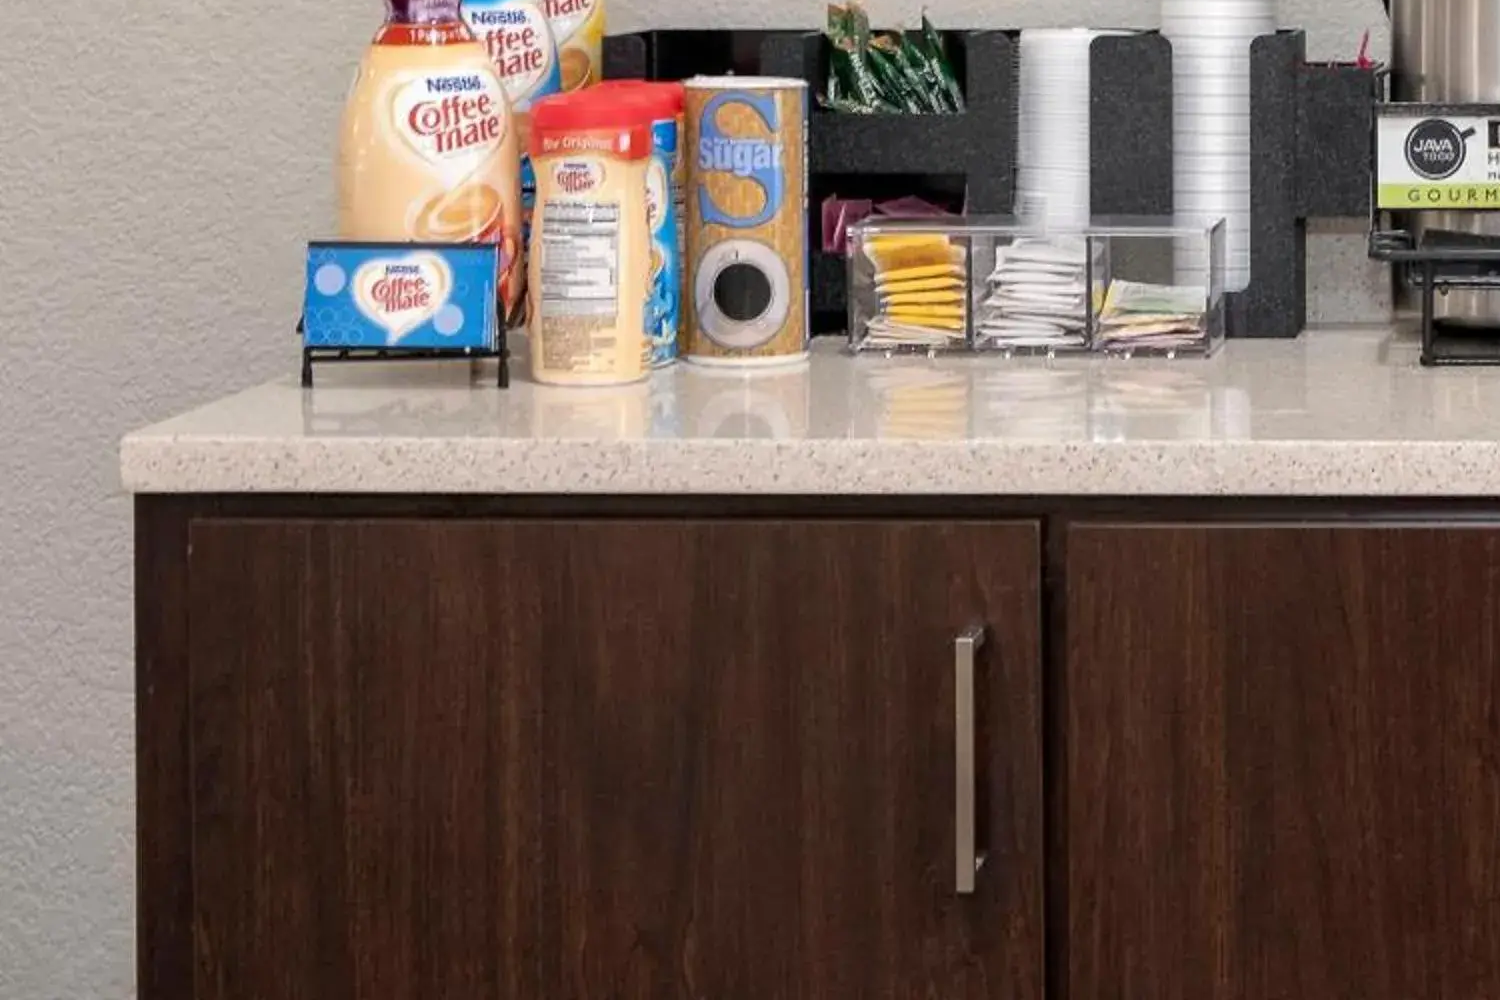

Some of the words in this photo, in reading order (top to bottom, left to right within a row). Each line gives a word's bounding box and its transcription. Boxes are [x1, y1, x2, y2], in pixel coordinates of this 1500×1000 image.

[486, 27, 535, 56] ffee
[408, 94, 492, 136] Coffee
[435, 115, 500, 153] mate
[1412, 138, 1453, 152] JAVA
